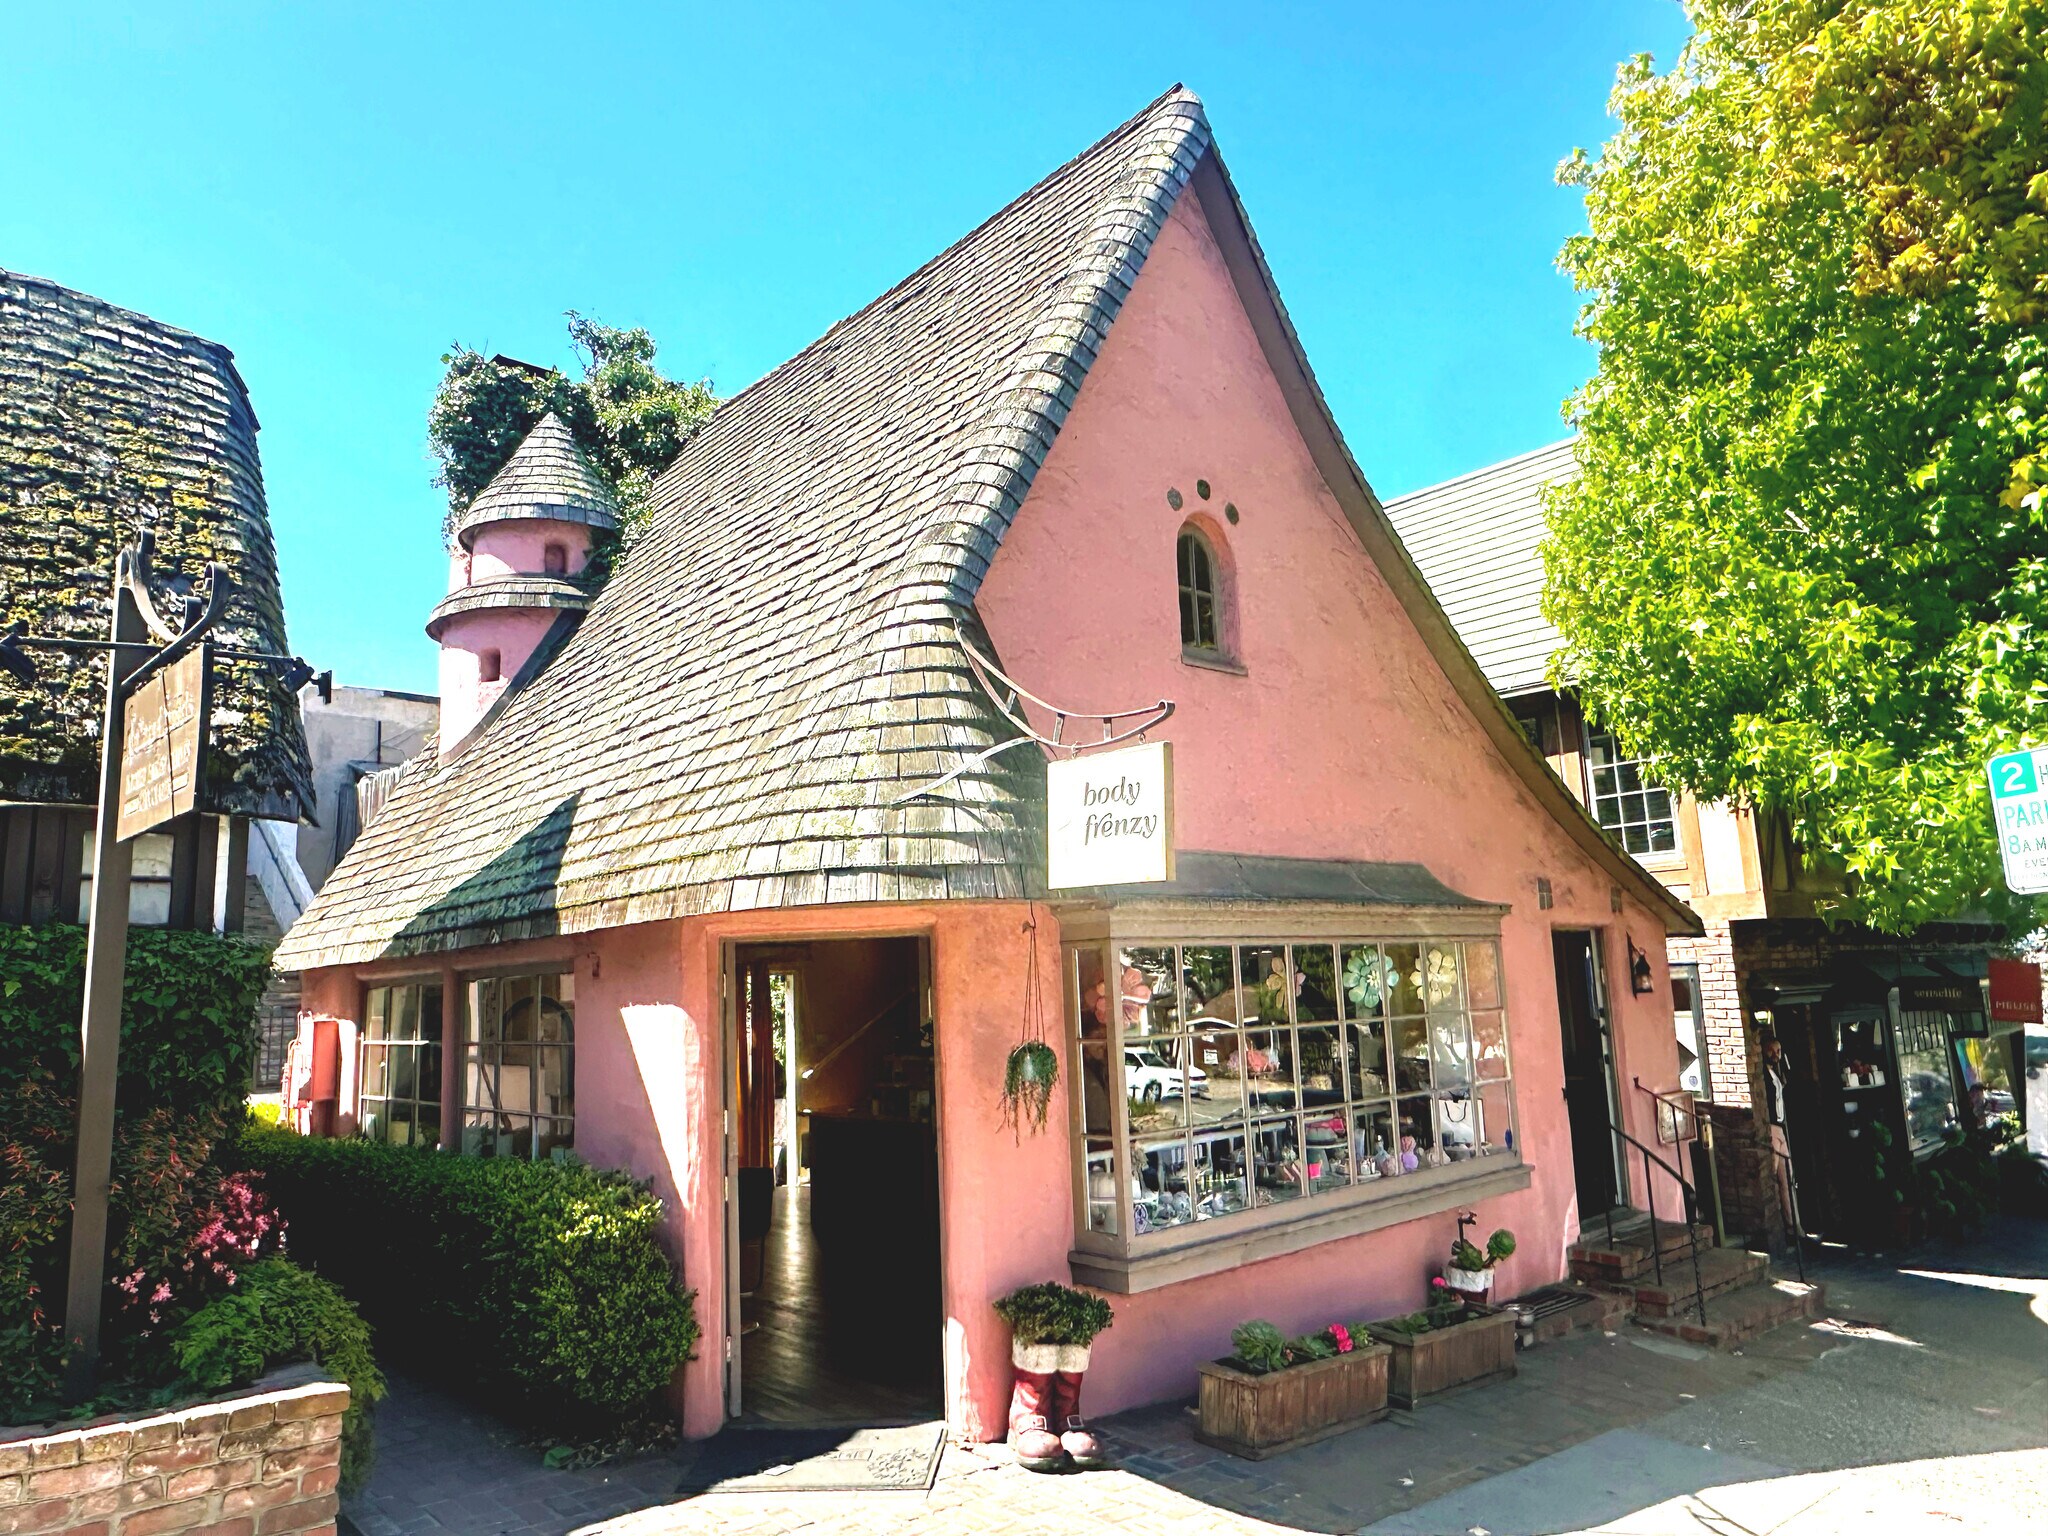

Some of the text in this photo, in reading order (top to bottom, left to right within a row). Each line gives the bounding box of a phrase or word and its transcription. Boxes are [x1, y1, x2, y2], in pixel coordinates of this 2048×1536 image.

[1084, 776, 1140, 806] body
[2001, 762, 2026, 792] 2
[1085, 812, 1157, 845] frenzy
